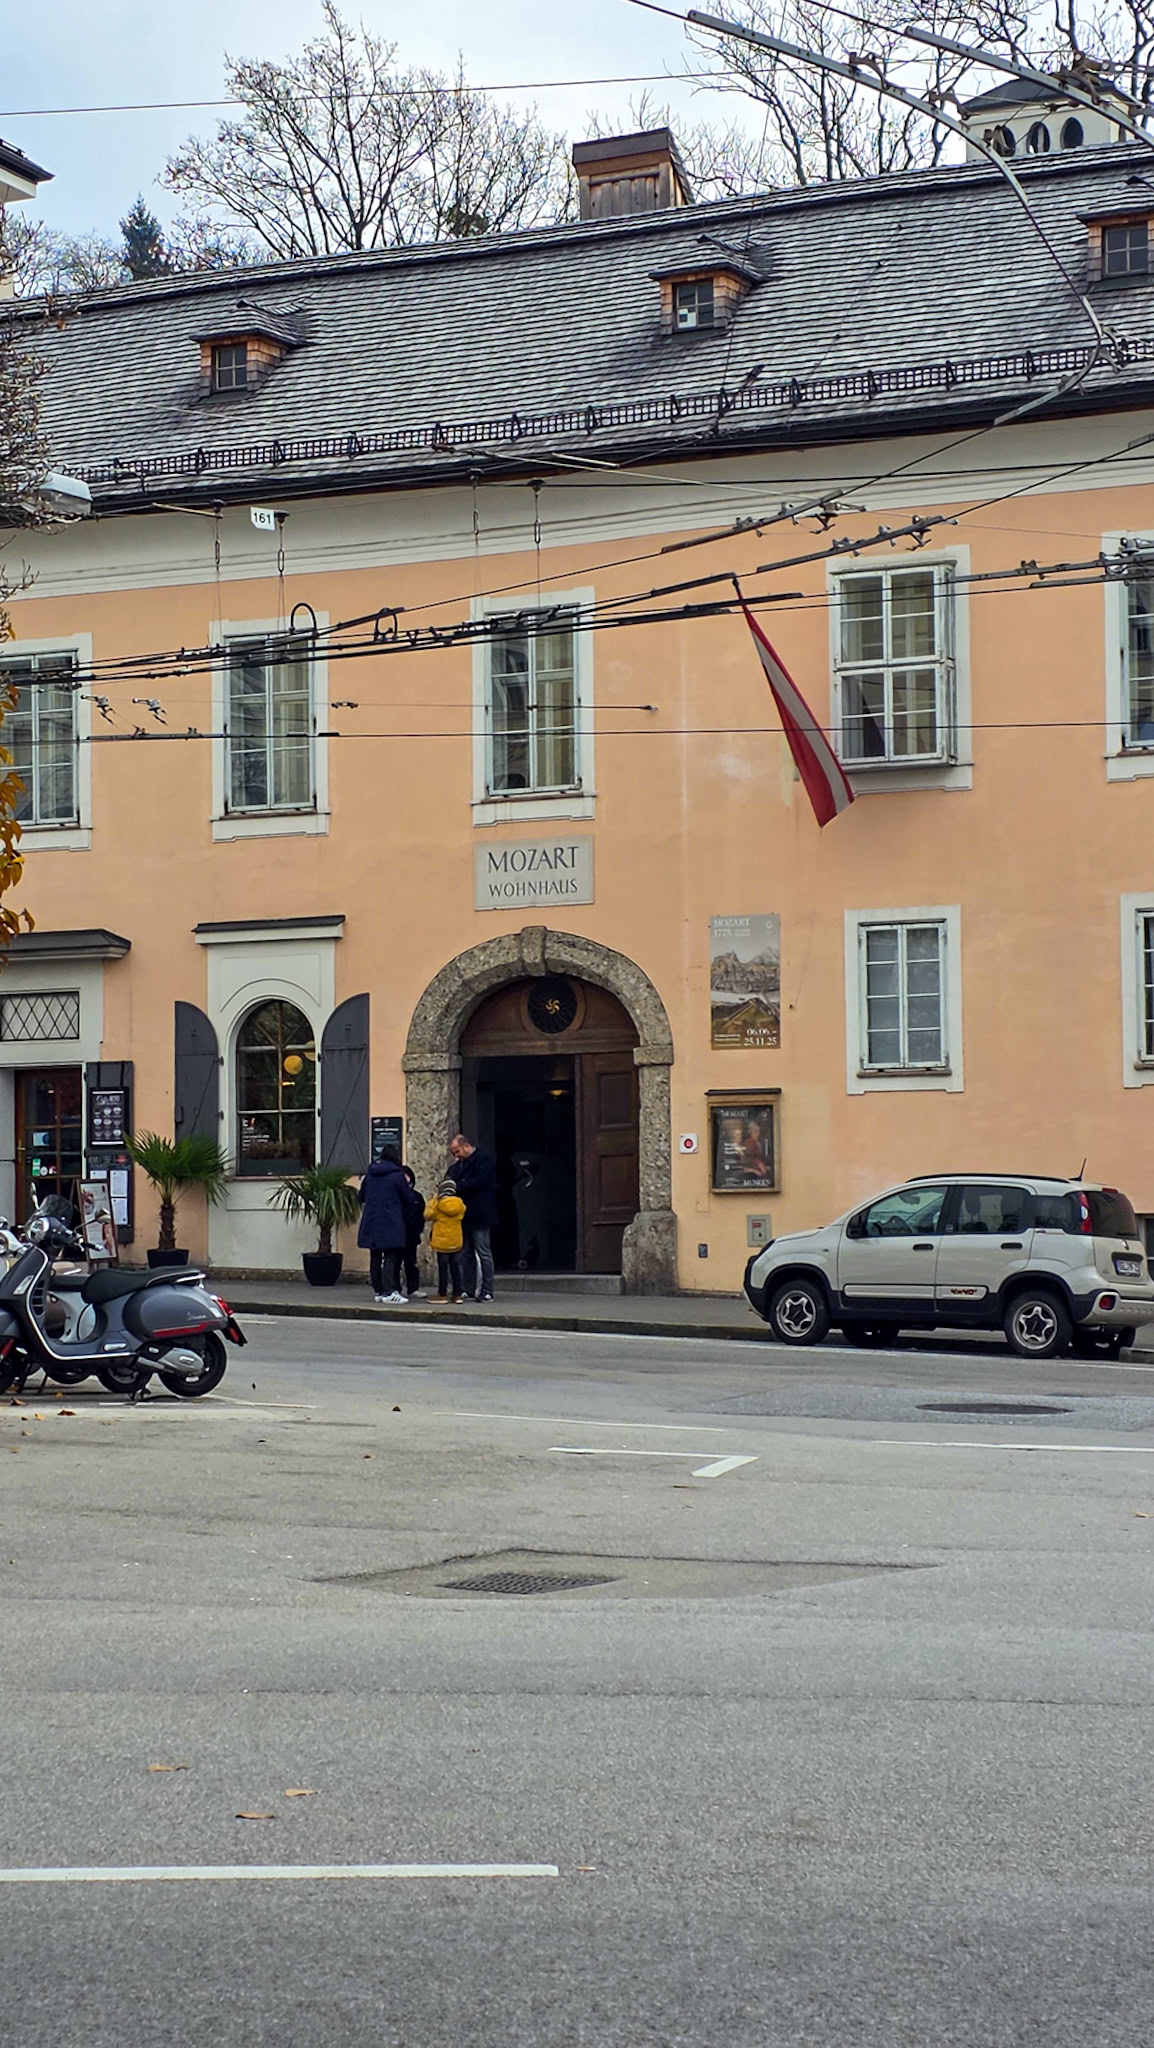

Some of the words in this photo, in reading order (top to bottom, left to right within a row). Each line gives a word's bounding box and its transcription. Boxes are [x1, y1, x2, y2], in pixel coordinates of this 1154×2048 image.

[253, 512, 271, 524] 161
[488, 846, 579, 873] MOZART
[488, 879, 578, 898] WOHNHAUS
[713, 918, 751, 928] MOZART
